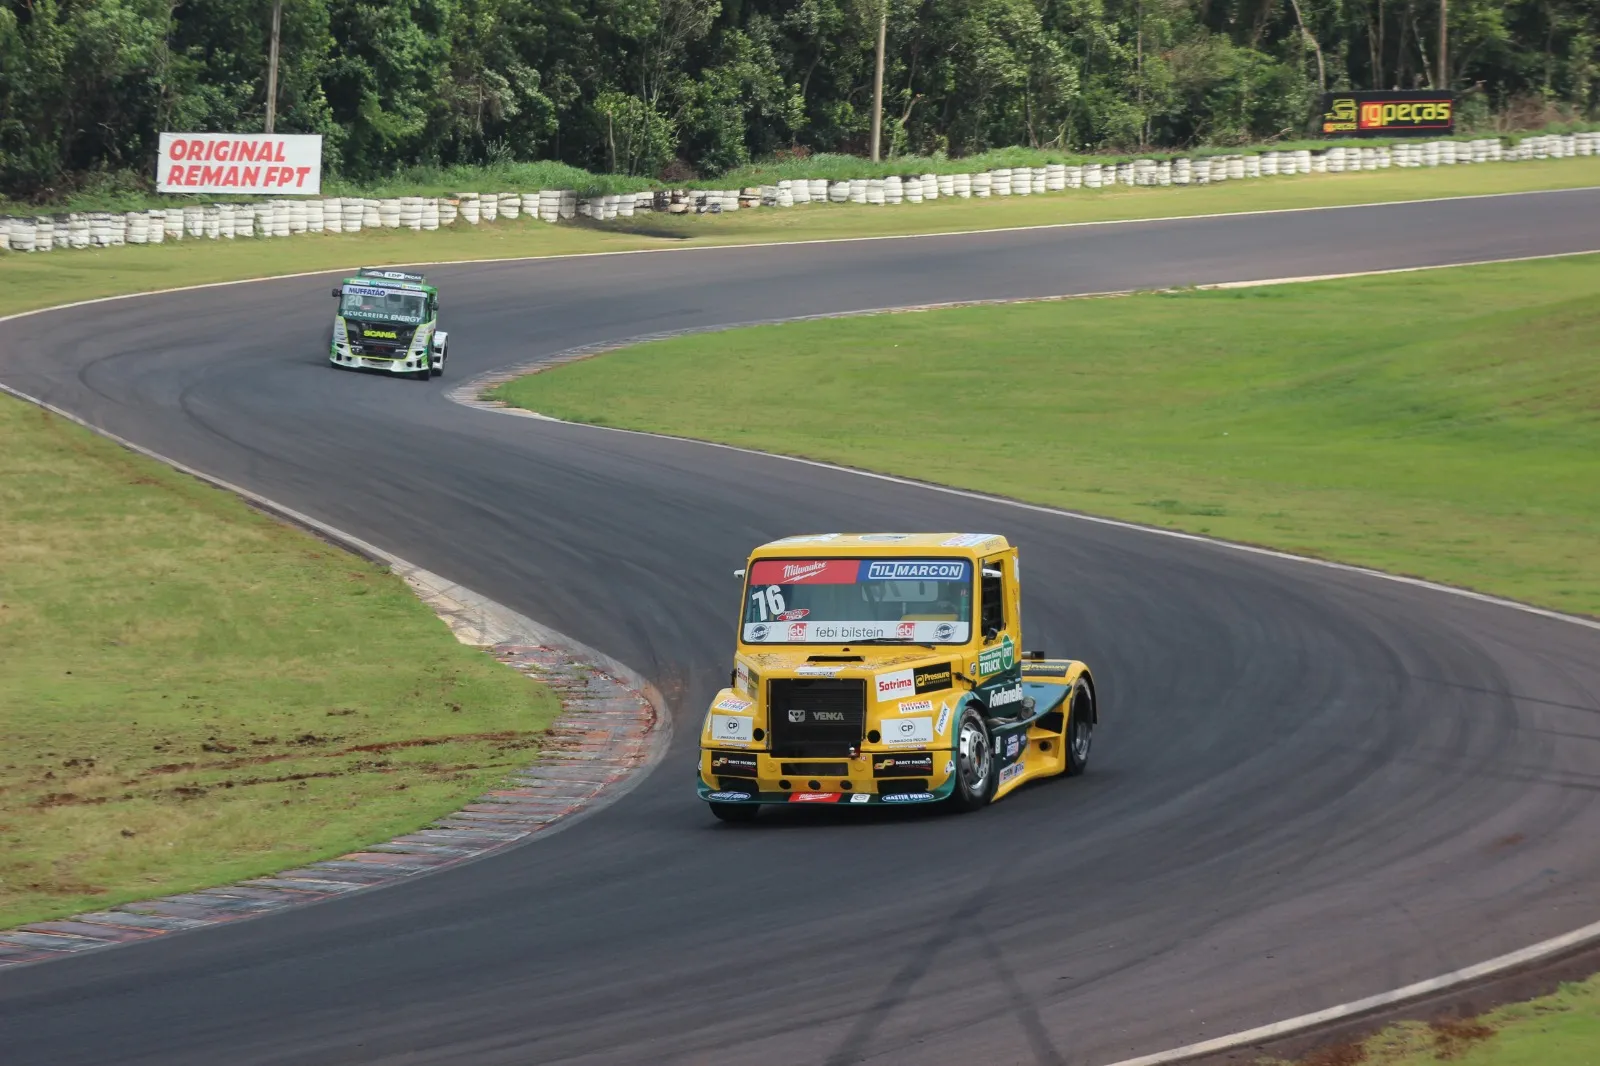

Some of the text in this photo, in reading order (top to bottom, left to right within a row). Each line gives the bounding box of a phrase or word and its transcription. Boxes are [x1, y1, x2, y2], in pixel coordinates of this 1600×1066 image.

[169, 139, 287, 162] ORIGINAL
[166, 165, 311, 187] REMAN FPT
[347, 295, 363, 307] 20
[390, 314, 422, 323] ENERGY
[363, 330, 397, 339] SCANIA
[782, 561, 827, 578] Milwaukee
[752, 585, 785, 621] 76
[816, 627, 884, 637] febi bilstein
[980, 659, 1001, 674] TRUCK
[924, 671, 950, 682] Pressure
[879, 678, 912, 692] Sotrima
[813, 711, 845, 720] VENKA
[901, 724, 913, 732] CP
